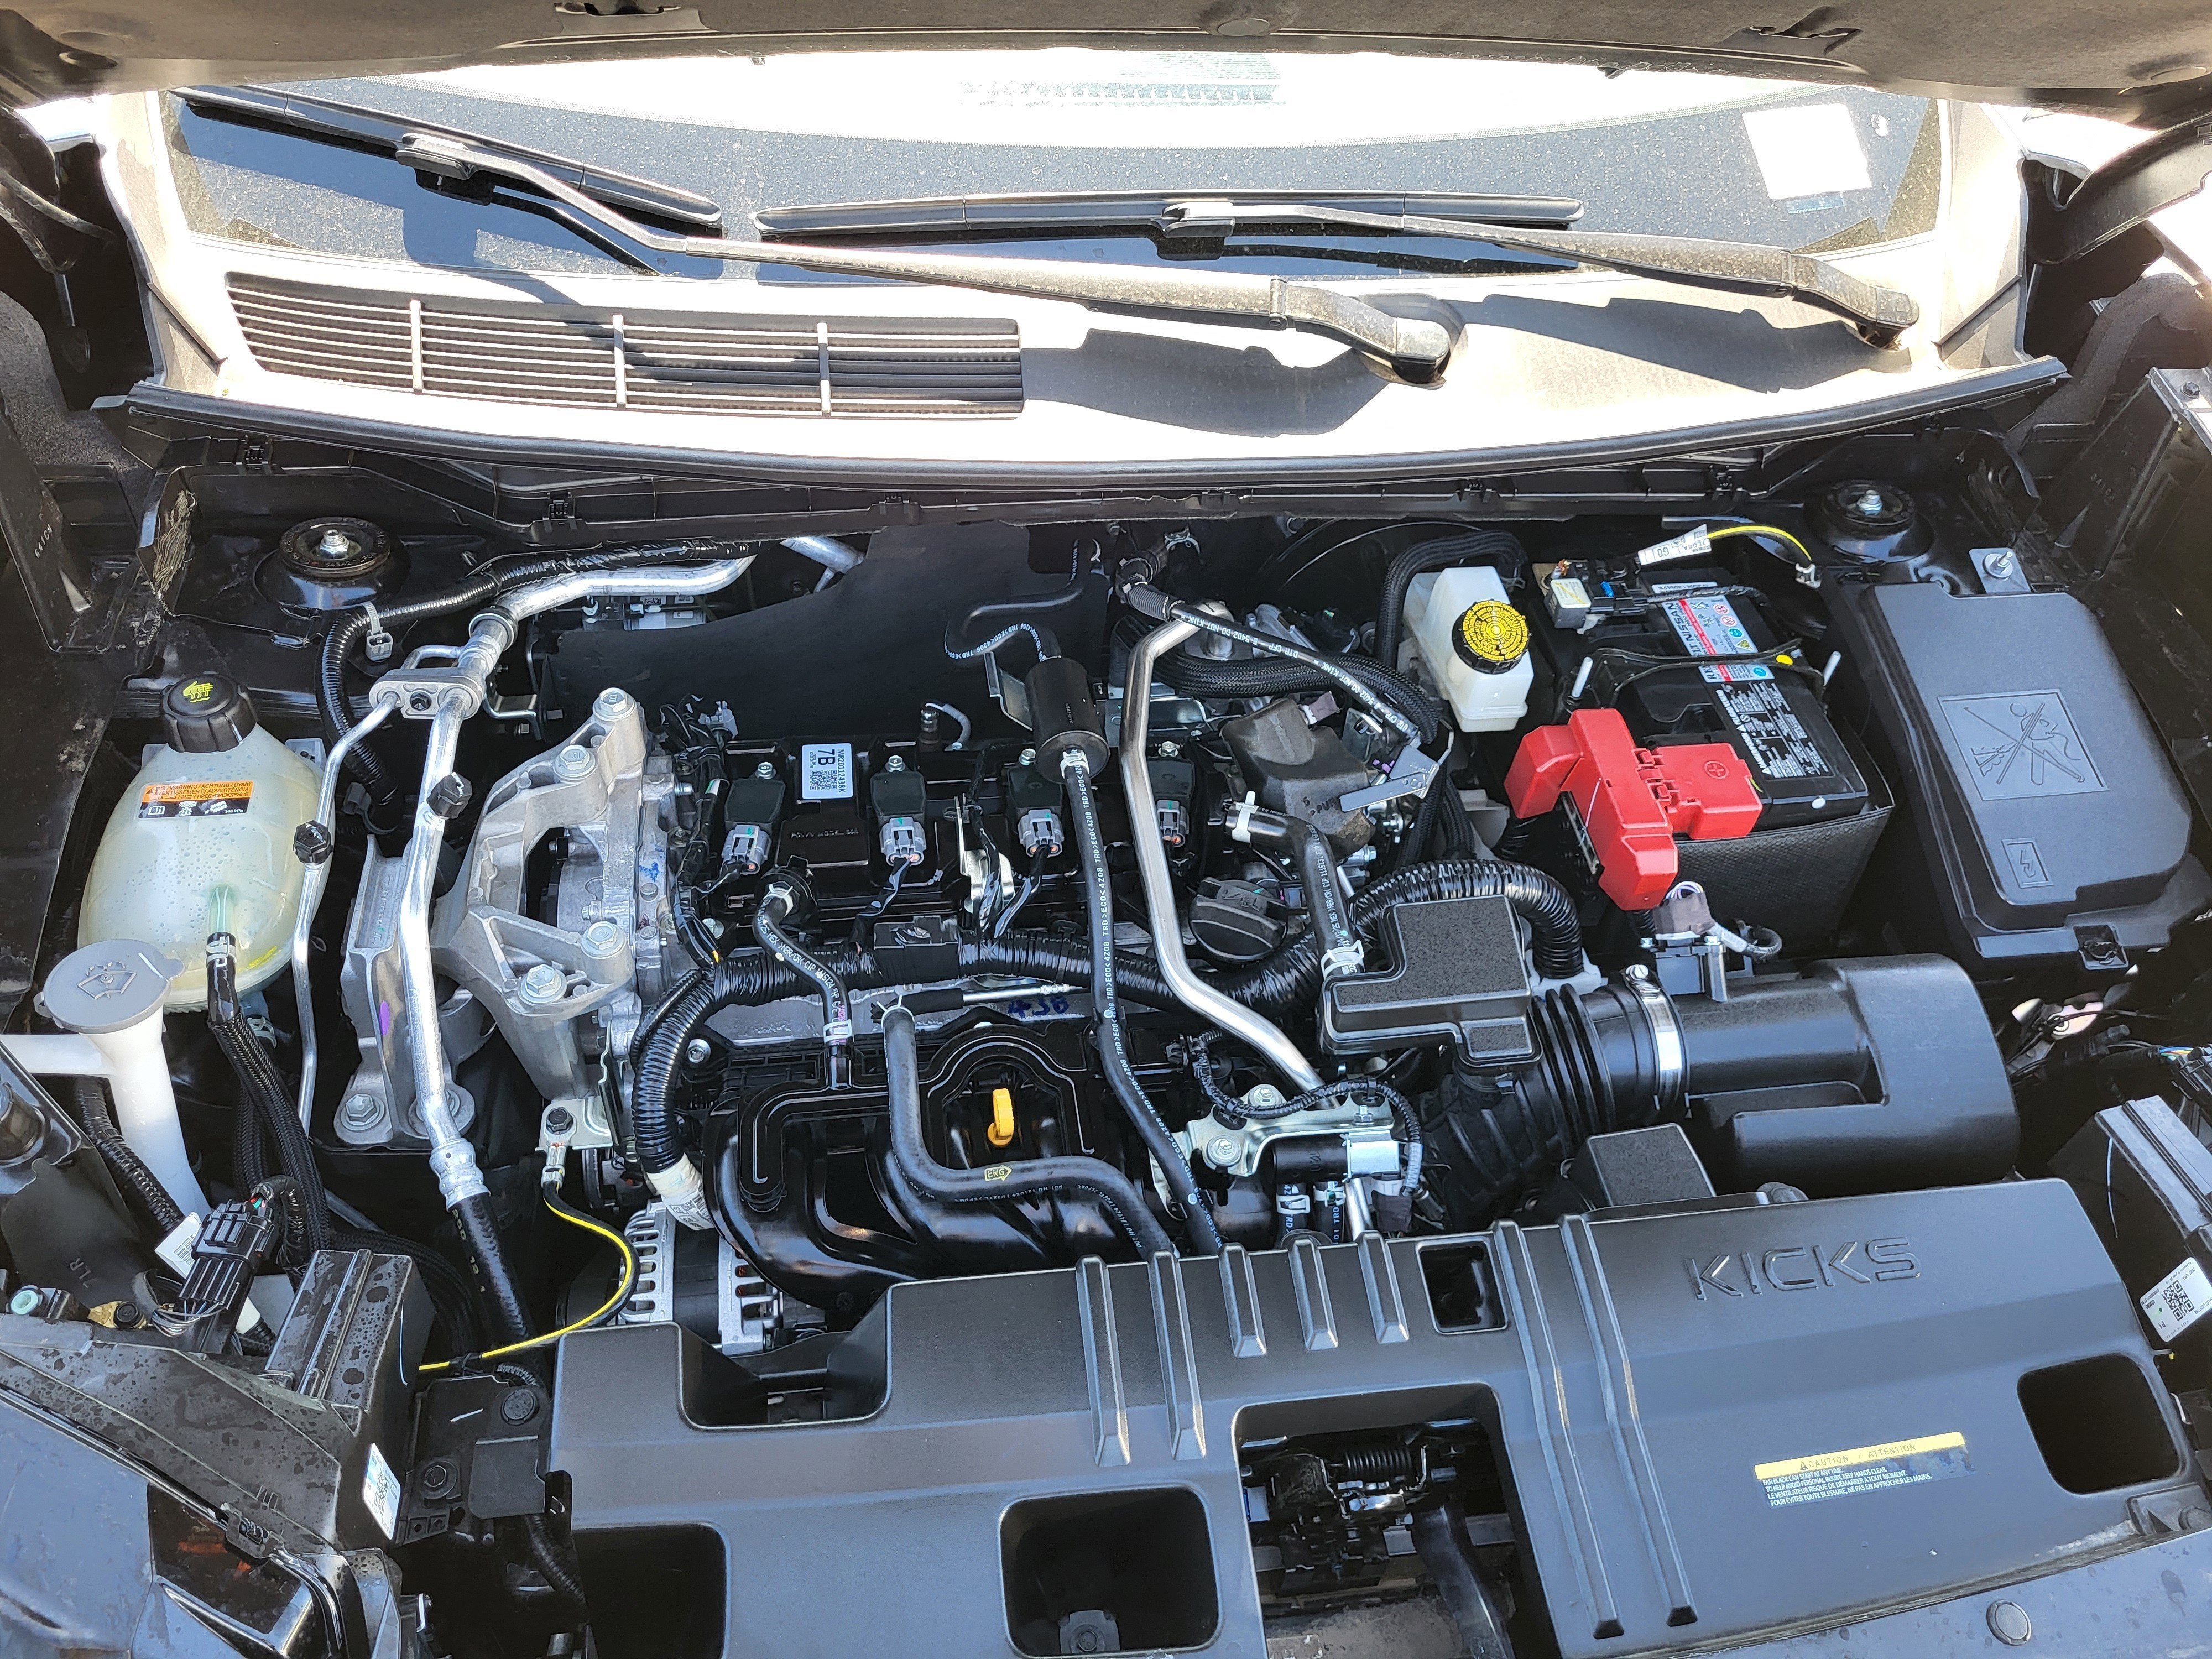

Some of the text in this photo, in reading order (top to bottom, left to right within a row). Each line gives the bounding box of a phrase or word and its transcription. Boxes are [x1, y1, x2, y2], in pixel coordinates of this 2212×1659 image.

[1188, 612, 1204, 627] KINK
[1208, 622, 1220, 633] NOT
[1666, 603, 1693, 641] NISSAN
[1268, 641, 1282, 653] CFP
[1321, 661, 1340, 676] KINK
[818, 749, 836, 765] 7B
[837, 748, 846, 792] MR20112438K
[987, 1168, 1005, 1179] ENG
[1683, 1236, 1922, 1301] KICKS
[1808, 1443, 1916, 1469] CAUTION ATTENTION
[1788, 1474, 1799, 1482] CAN
[1801, 1478, 1825, 1487] PERSONAL
[1853, 1469, 1871, 1477] HANDS
[1774, 1487, 1808, 1499] VENTILATEUR
[1808, 1483, 1828, 1493] RISQUE
[1835, 1478, 1865, 1488] DÉMARRER
[1786, 1494, 1804, 1504] ÉVITER
[1804, 1492, 1821, 1501] TOUTE
[1874, 1478, 1904, 1489] APPROCHER
